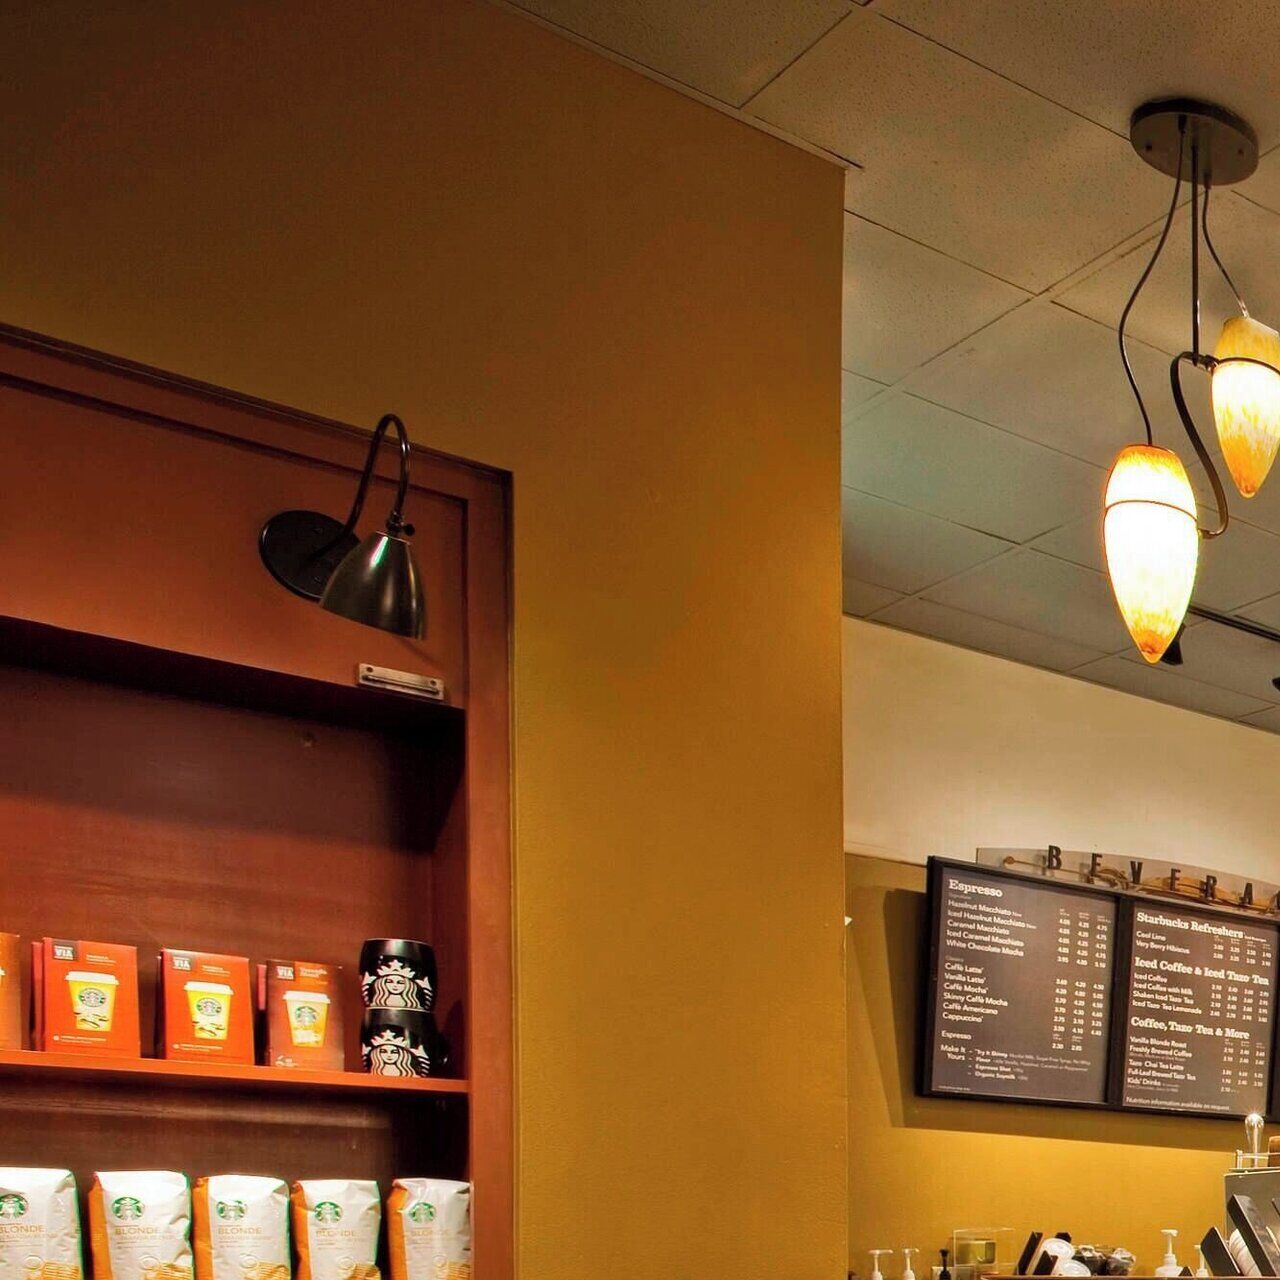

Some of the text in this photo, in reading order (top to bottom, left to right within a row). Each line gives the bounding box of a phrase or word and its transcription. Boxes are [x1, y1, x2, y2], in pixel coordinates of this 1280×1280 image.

[949, 880, 1003, 898] Espresso
[948, 900, 1012, 916] Hazelnut Macchiato
[948, 909, 1026, 928] Iced Hazelnut Macchiato
[947, 919, 1011, 935] Caramel Macchiato
[1137, 912, 1190, 930] Starbucks
[1190, 920, 1244, 939] Refreshers
[947, 929, 1025, 947] Iced Caramel Macchiato
[1136, 931, 1167, 941] Cool Lime
[946, 939, 1025, 957] White Chocolate Mocha
[1136, 940, 1190, 954] Very Berry Hibiscus
[944, 973, 967, 982] Vanilla
[1135, 957, 1269, 986] Iced Coffee & Iced Tazo Tea
[1148, 974, 1168, 983] Coffee
[1132, 990, 1155, 999] Shaken
[1148, 983, 1167, 992] Coffee
[1181, 987, 1193, 995] Milk
[943, 992, 966, 1003] Skinny
[985, 998, 1009, 1007] Mocha
[963, 1005, 998, 1015] Americano
[1132, 999, 1146, 1007] Iced
[1161, 1003, 1172, 1011] Tea
[1172, 1005, 1202, 1014] Lemonade
[1131, 1016, 1168, 1031] Coffee,
[1195, 1024, 1214, 1036] Tea
[1215, 1026, 1223, 1036] &
[1224, 1028, 1250, 1040] More
[942, 1030, 972, 1040] Espresso
[941, 1044, 960, 1054] Make
[1130, 1036, 1149, 1045] Vanilla
[1171, 1041, 1187, 1049] Roast
[946, 1052, 966, 1061] Yours
[1129, 1045, 1150, 1054] Freshly
[1150, 1047, 1173, 1056] Brewed
[1173, 1050, 1193, 1058] Coffee
[1144, 1060, 1159, 1068] Chai
[1170, 1063, 1184, 1071] Latte
[1142, 1078, 1161, 1087] Drinks
[1126, 1097, 1150, 1105] Nutrition
[1151, 1098, 1180, 1107] information
[1180, 1101, 1203, 1109] available
[115, 1226, 160, 1235] BLONDE
